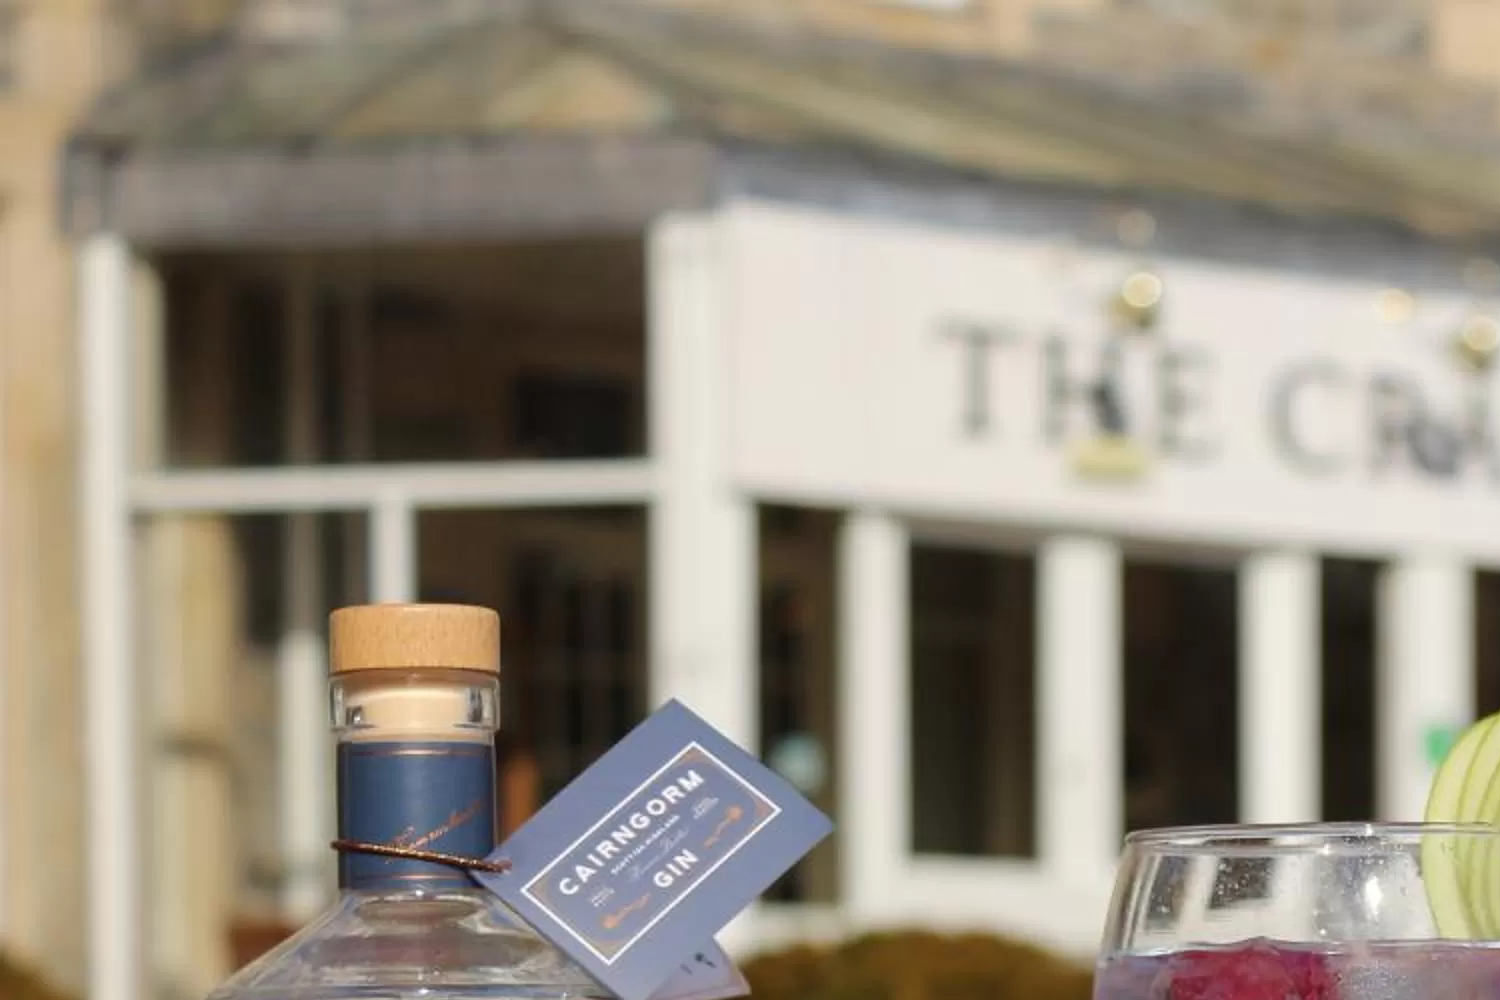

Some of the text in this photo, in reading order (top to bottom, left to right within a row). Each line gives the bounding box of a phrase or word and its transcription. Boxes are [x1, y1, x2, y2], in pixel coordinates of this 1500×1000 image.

[937, 315, 1217, 466] THE
[559, 769, 704, 895] CAIRNGORM
[653, 848, 699, 888] GIN
